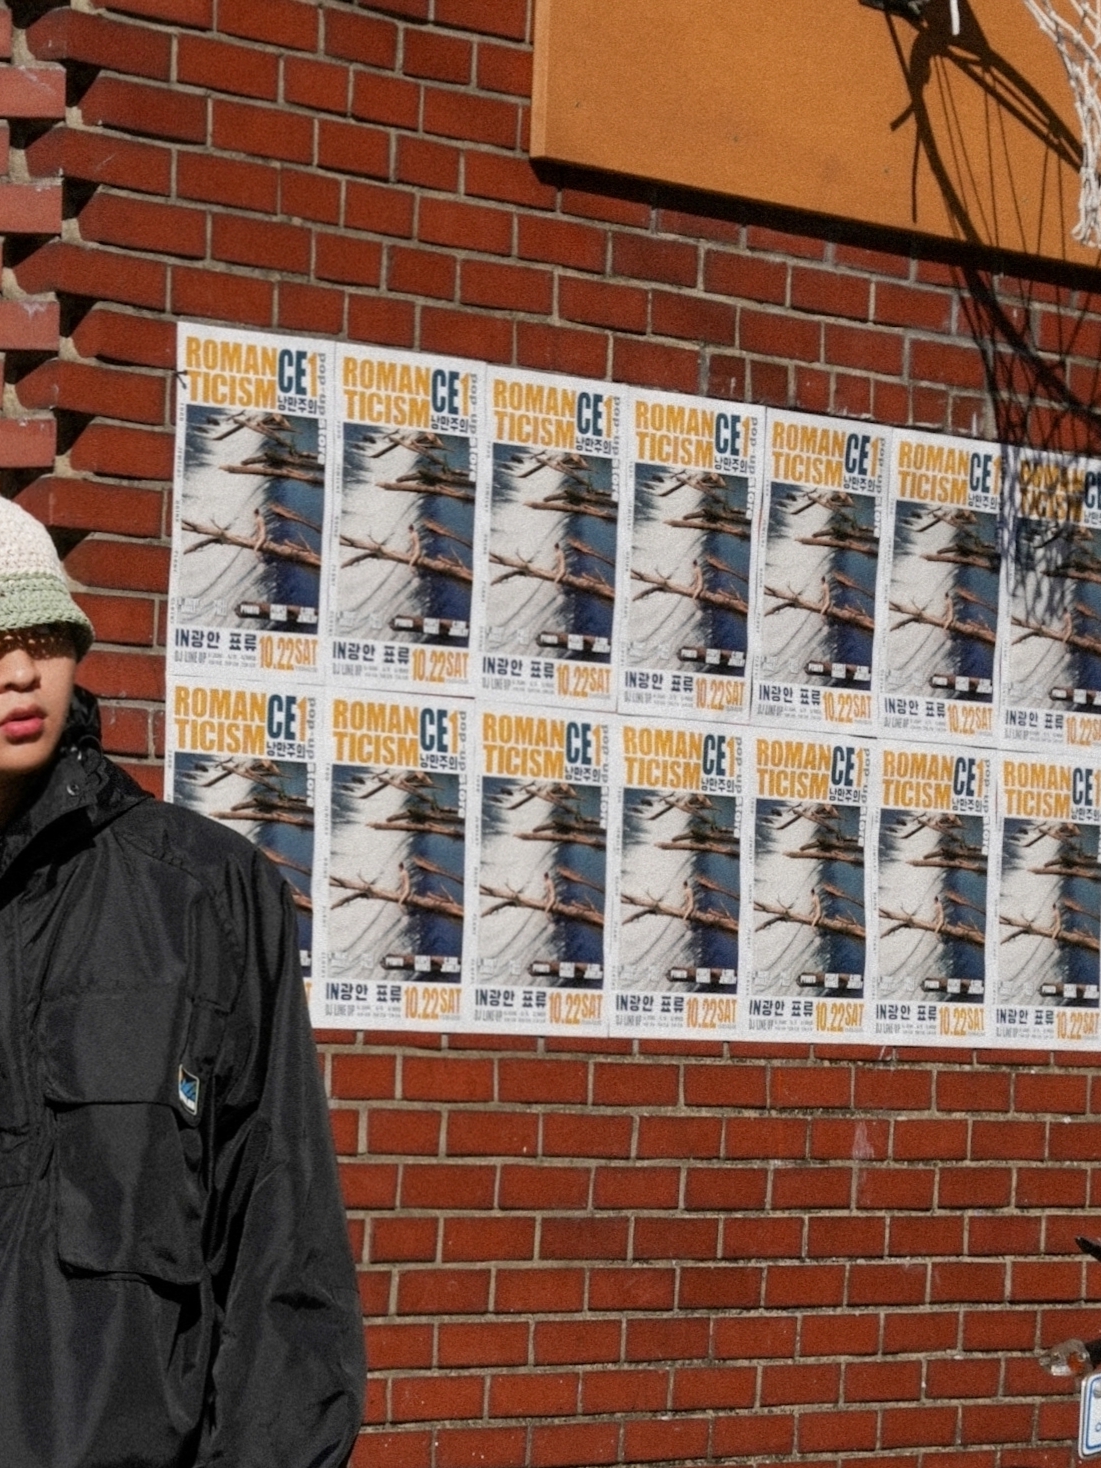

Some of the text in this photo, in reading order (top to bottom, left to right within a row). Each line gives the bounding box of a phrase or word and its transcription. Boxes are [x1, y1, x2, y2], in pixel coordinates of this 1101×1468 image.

[186, 371, 276, 409] TICISM
[344, 390, 429, 428] TICISM
[495, 411, 575, 449] TICISM
[175, 719, 265, 755] TICISM
[334, 733, 418, 766] TICISM
[484, 745, 564, 779] TICISM
